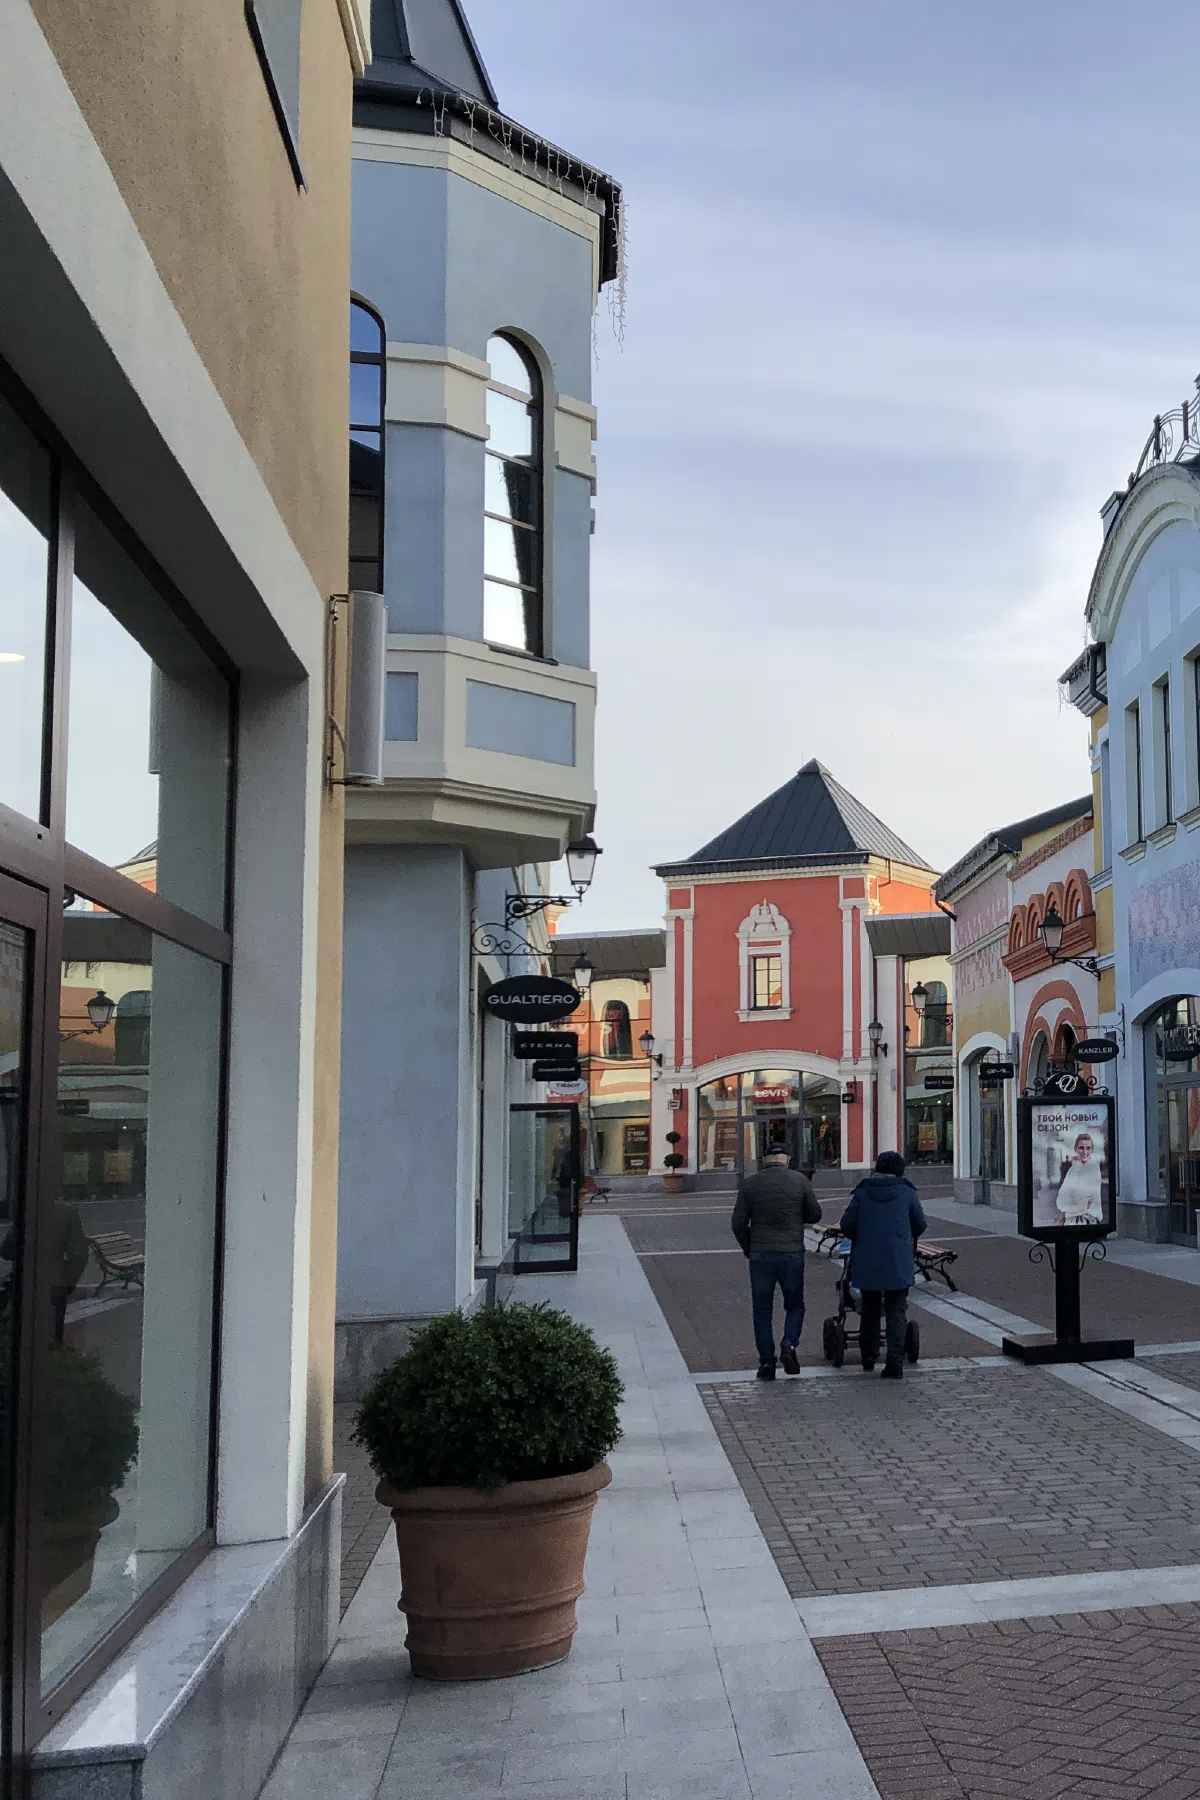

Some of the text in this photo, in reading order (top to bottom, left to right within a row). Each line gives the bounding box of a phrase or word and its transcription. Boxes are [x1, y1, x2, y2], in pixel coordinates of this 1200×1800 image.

[487, 994, 575, 1004] GUALTIERO
[1037, 1112, 1098, 1122] ТВОЙ НОВЫЙ
[1037, 1124, 1069, 1132] СЕЗОН
